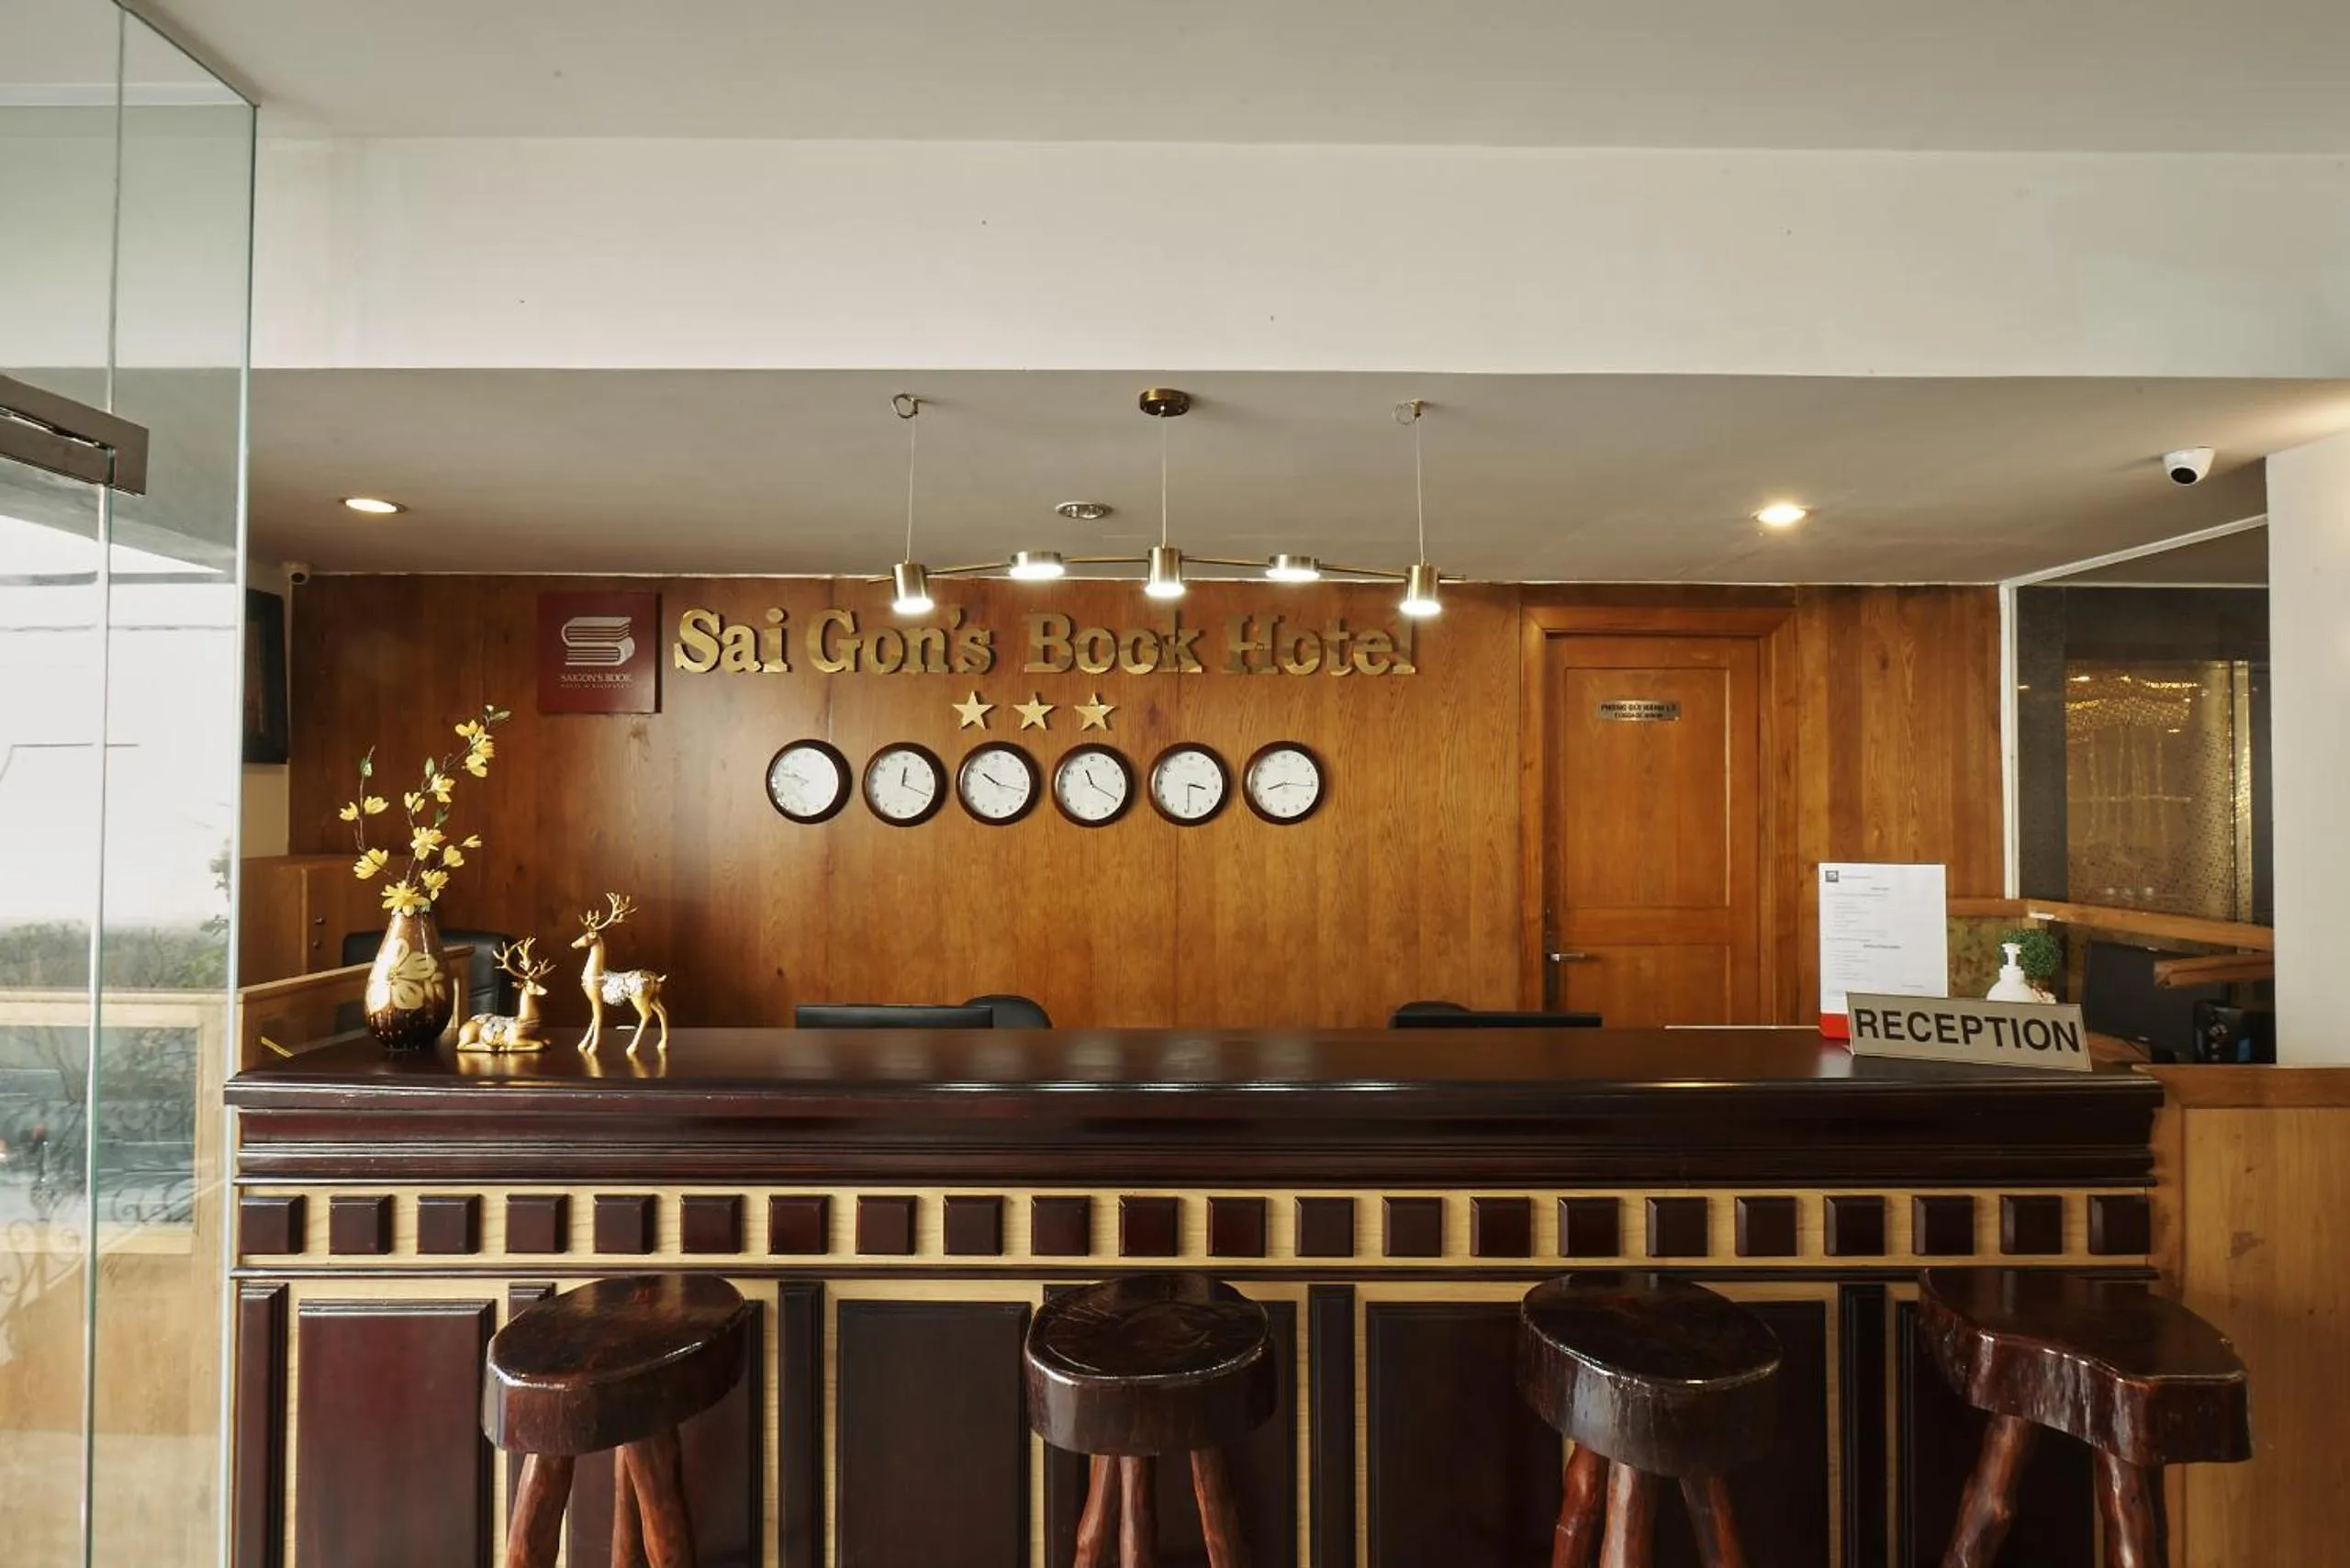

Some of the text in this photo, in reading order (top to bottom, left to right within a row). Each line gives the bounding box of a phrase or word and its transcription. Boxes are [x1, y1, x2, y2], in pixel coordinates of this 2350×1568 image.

[674, 607, 1416, 677] Sai Gon's Book Hotel
[1853, 1008, 2080, 1053] RECEPTION
